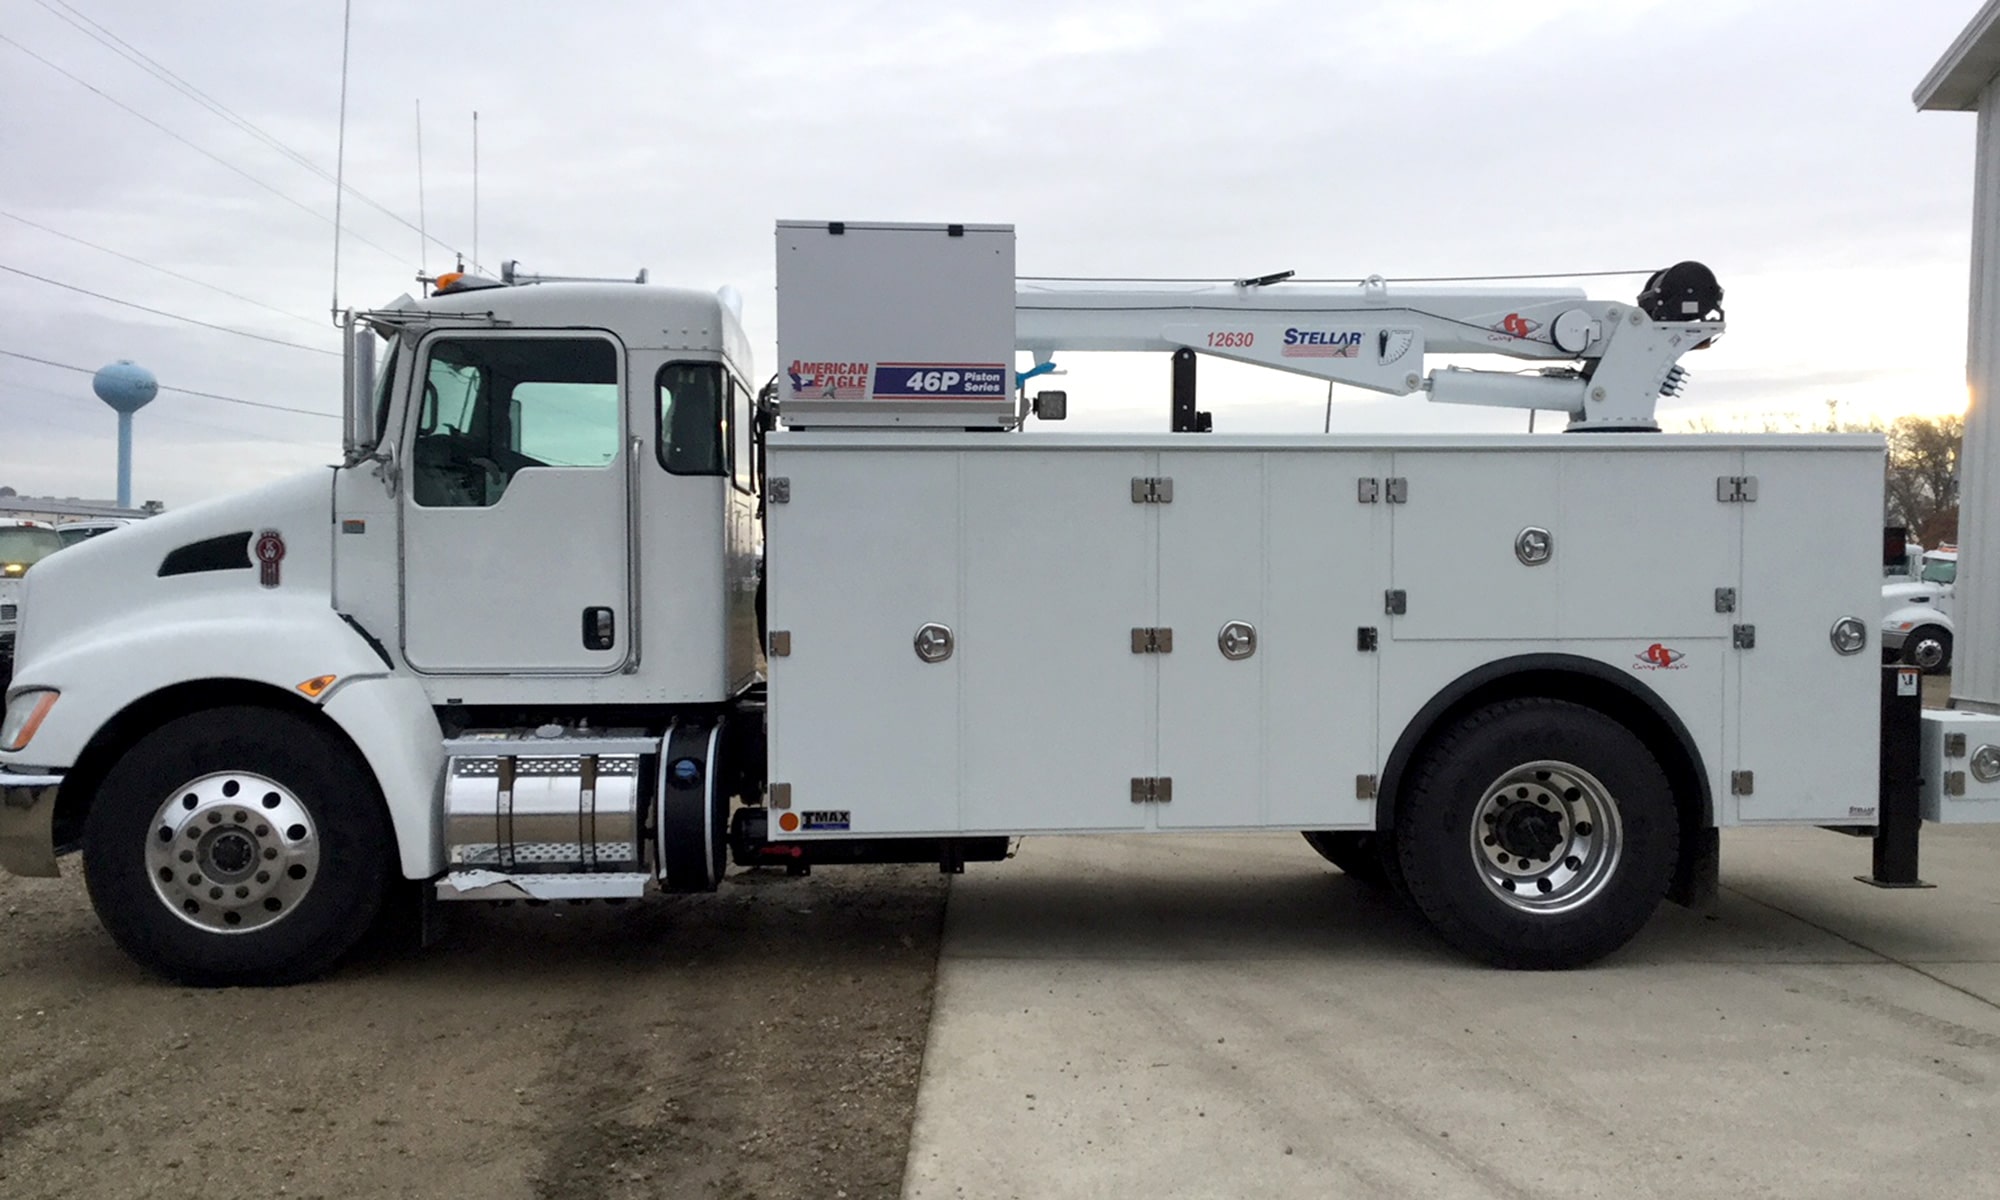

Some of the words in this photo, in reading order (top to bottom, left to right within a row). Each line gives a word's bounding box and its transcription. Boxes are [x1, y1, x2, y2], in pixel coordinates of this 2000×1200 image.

[1206, 331, 1255, 348] 12630
[1283, 327, 1362, 346] STELLAR
[789, 359, 869, 376] AMERICAN
[813, 375, 867, 389] EAGLE
[906, 371, 960, 392] 46P
[964, 371, 1000, 382] Piston
[964, 382, 1000, 393] Series
[801, 811, 849, 830] TMAX
